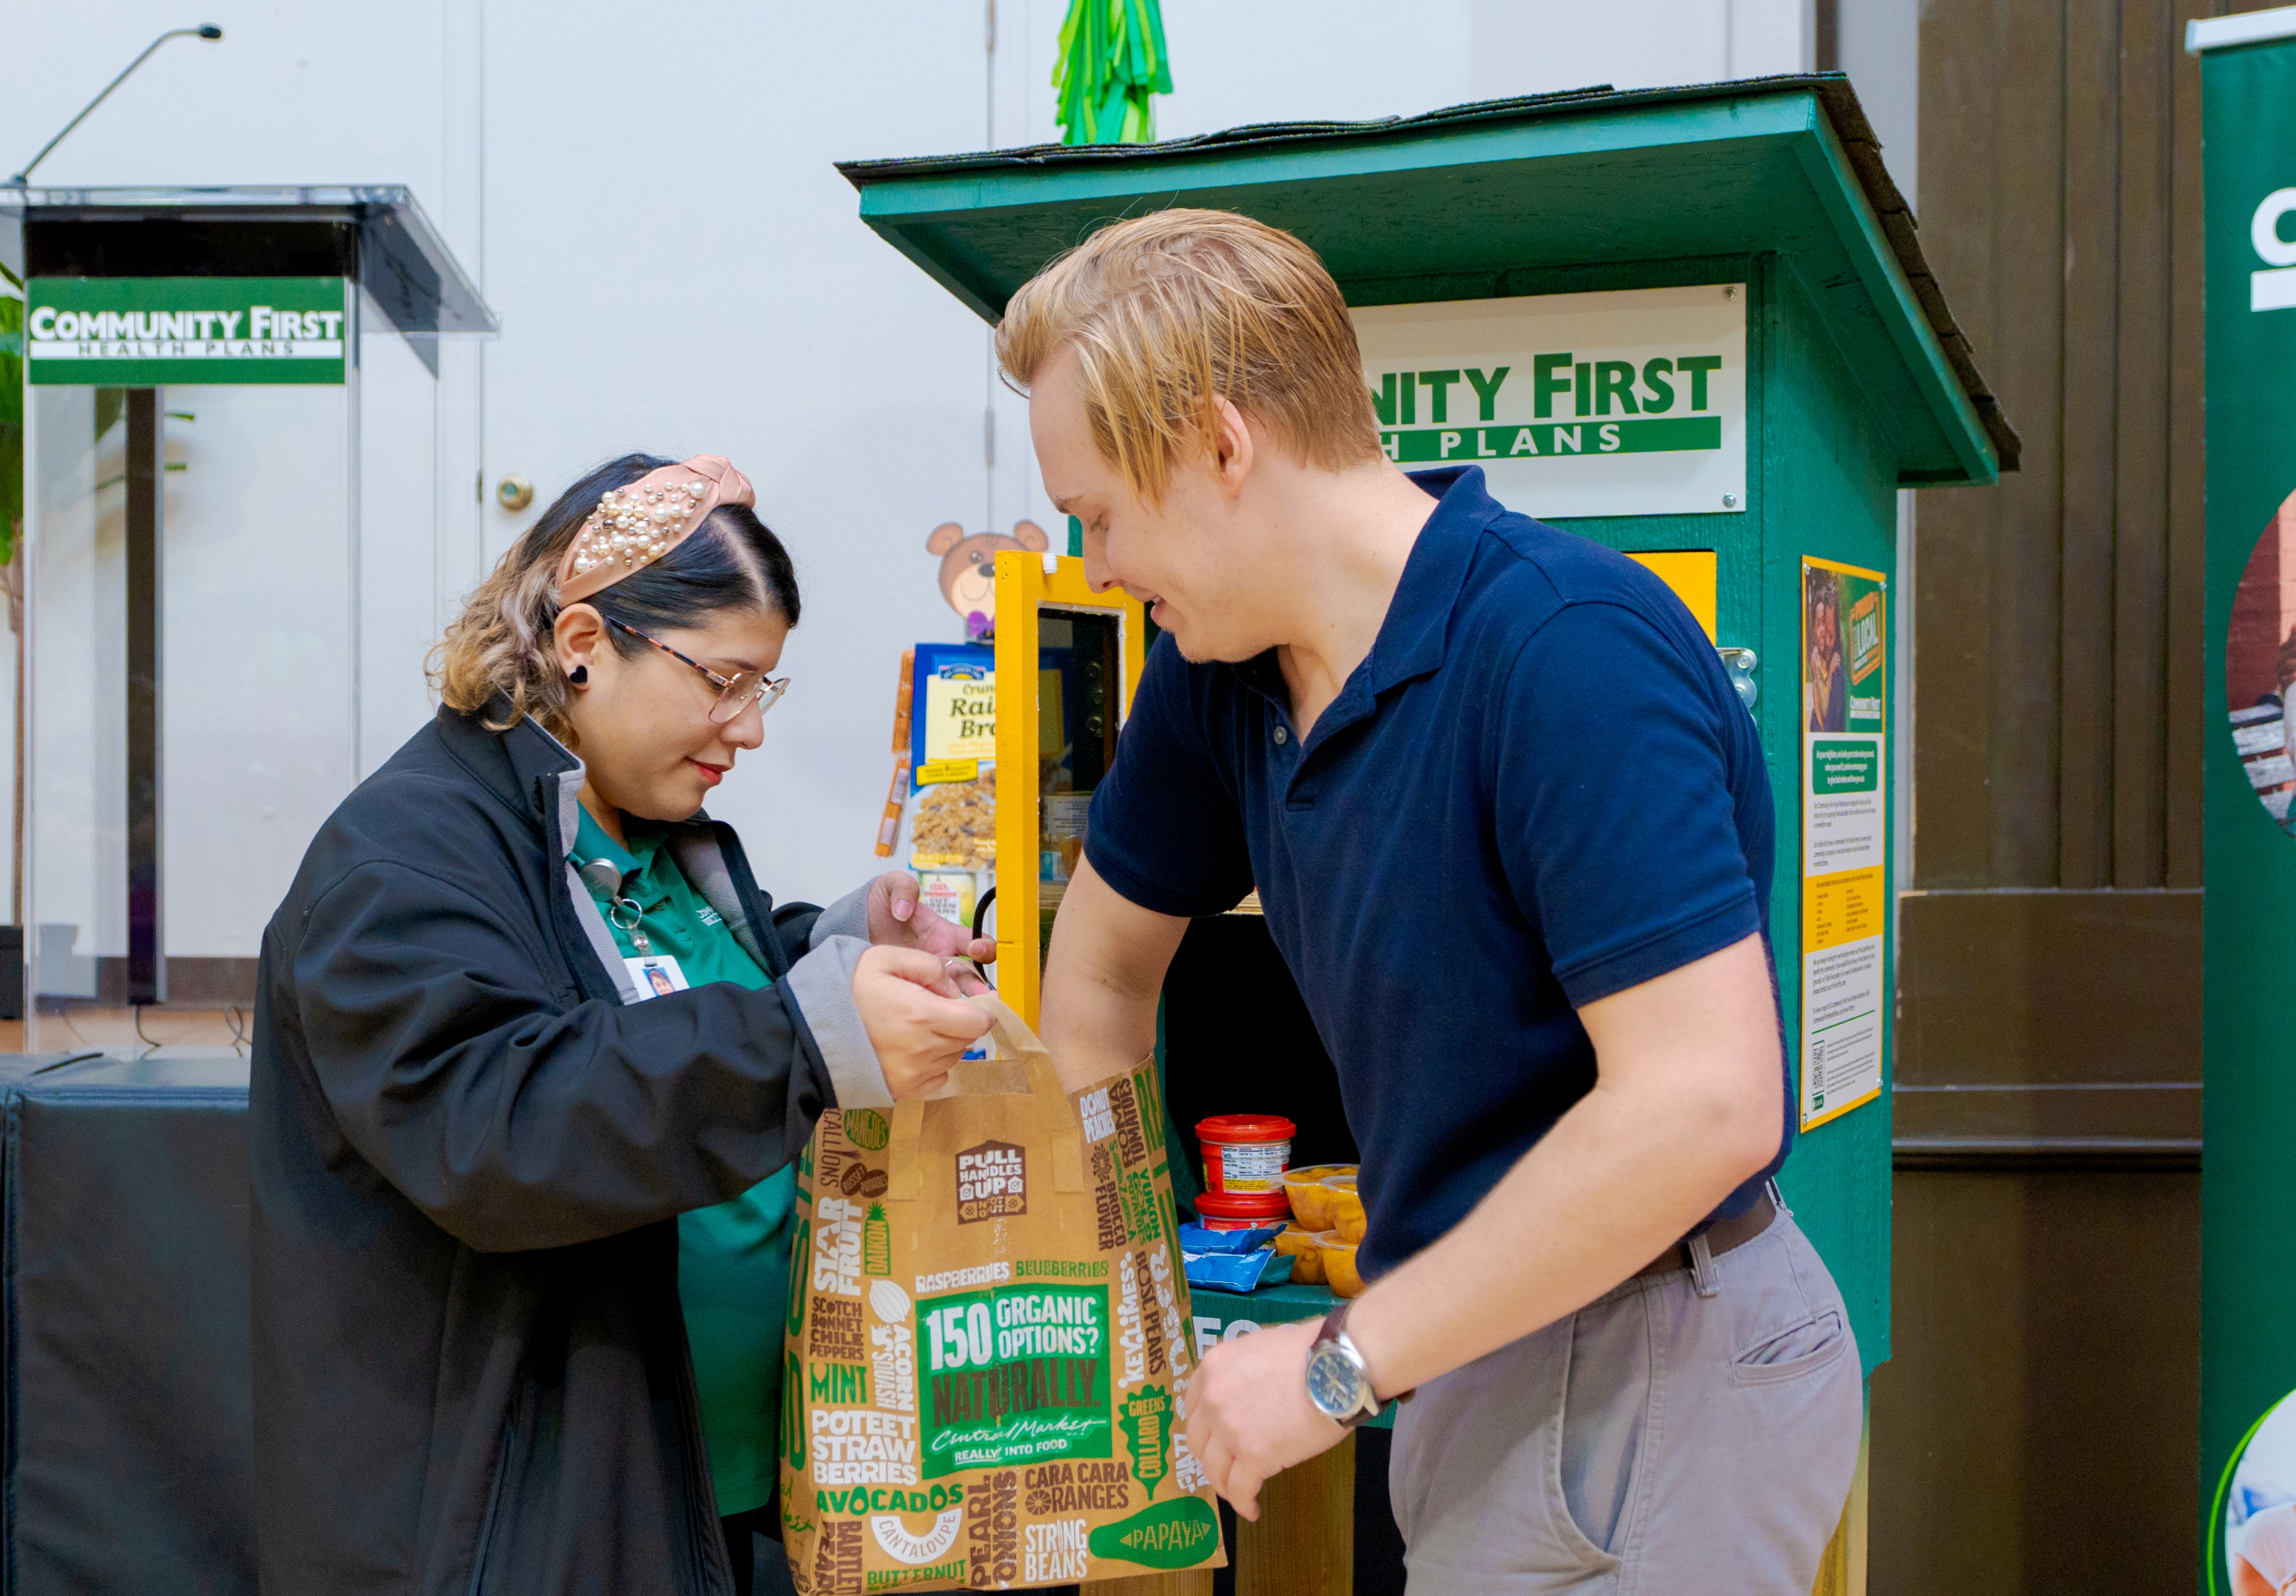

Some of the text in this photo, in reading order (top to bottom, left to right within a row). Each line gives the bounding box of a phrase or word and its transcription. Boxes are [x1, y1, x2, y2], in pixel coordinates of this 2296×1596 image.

[30, 306, 343, 341] COMMUNITY FIRST
[79, 341, 294, 357] HEALTH PLANS
[1534, 352, 1722, 419] FIRST
[1440, 424, 1621, 458] PLANS
[950, 697, 996, 717] Rai
[1079, 1087, 1110, 1120] DONUT
[1109, 1081, 1133, 1168] ROMA
[1120, 1078, 1146, 1165] TOMATOES
[820, 1108, 848, 1188] CALLIONS
[959, 1149, 1022, 1170] PULL
[843, 1166, 866, 1193] RUSSET
[959, 1164, 1022, 1183] HANDLES
[975, 1176, 1006, 1199] UP
[1095, 1184, 1114, 1252] FLOWER
[1106, 1180, 1126, 1247] BROCCO
[1133, 1171, 1152, 1243] GOLD
[1140, 1167, 1161, 1239] YUKON
[813, 1196, 843, 1294] STAR
[838, 1199, 863, 1297] FRUIT
[865, 1219, 888, 1274] DAIKON
[915, 1261, 1010, 1294] RASPBERRIES
[811, 1313, 863, 1332] BONNET
[812, 1296, 863, 1318] SCOTCH
[996, 1294, 1097, 1328] ORGANIC
[1135, 1250, 1167, 1376] BOSC PEARS
[809, 1342, 865, 1361] PEPPERS
[810, 1328, 864, 1347] CHILE
[926, 1302, 993, 1371] 150
[997, 1324, 1100, 1359] OPTIONS?
[893, 1323, 914, 1411] ACORN
[1118, 1333, 1144, 1388] KEY
[809, 1363, 867, 1404] MINT
[871, 1350, 896, 1410] SQUASH
[932, 1357, 1101, 1427] NATURALLY.
[1128, 1395, 1166, 1417] GREENS
[811, 1409, 916, 1440] POTEET
[932, 1415, 1107, 1452] Central Market
[812, 1435, 917, 1464] STRAW
[955, 1438, 1067, 1463] REALLY INTO FOOD
[1138, 1414, 1162, 1479] COLLARD
[813, 1461, 918, 1487] BERRIES
[1024, 1462, 1130, 1490] CARA CARA
[816, 1483, 963, 1516] AVOCADOS
[1024, 1484, 1129, 1516] ORANGES
[878, 1514, 956, 1558] CANTALOUPE
[967, 1475, 992, 1587] PEARL
[992, 1470, 1017, 1583] ONIONS
[1024, 1518, 1087, 1554] STRING
[1133, 1519, 1205, 1551] PAPAYA
[867, 1558, 967, 1586] BUTTERNUT
[1024, 1549, 1088, 1583] BEANS
